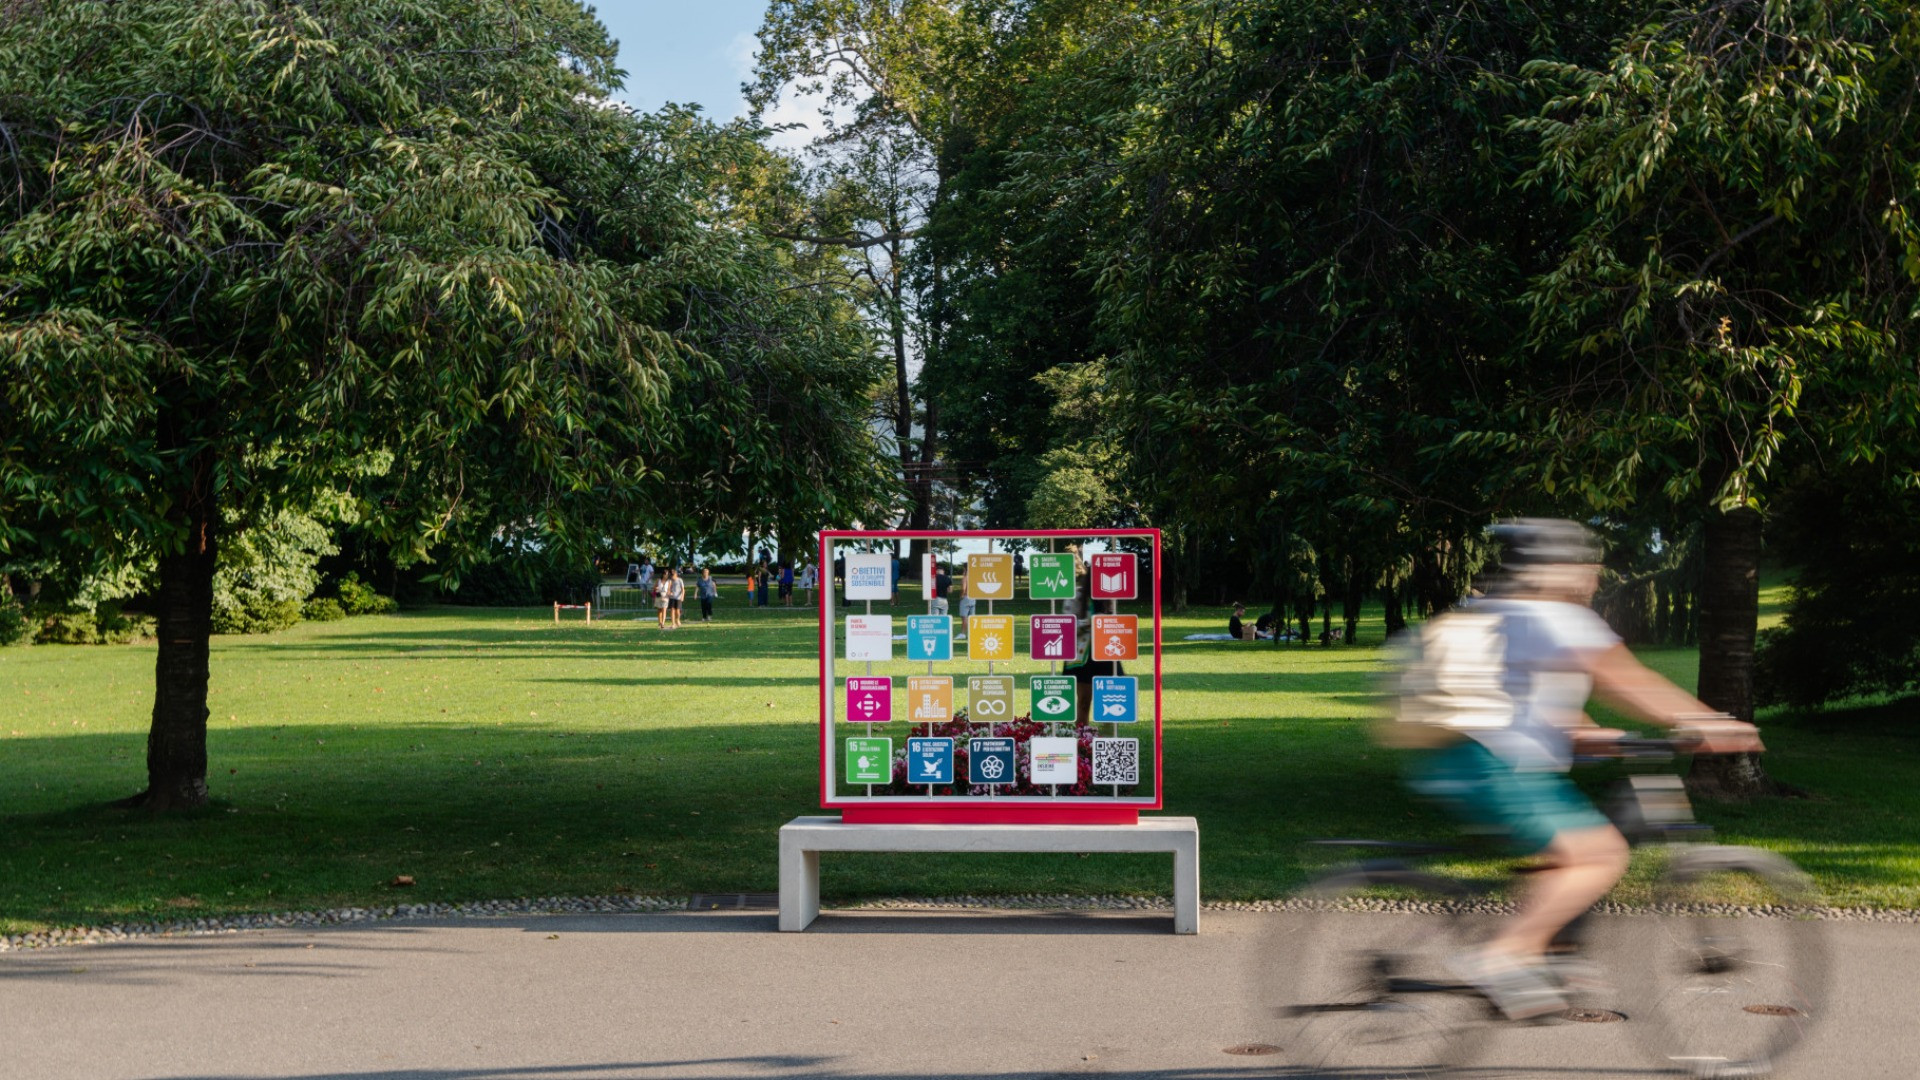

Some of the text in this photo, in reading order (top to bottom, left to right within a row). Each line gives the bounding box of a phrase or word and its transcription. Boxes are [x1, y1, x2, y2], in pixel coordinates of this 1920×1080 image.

[971, 558, 977, 567] 2
[1033, 558, 1039, 568] 3
[1094, 557, 1101, 567] 4
[910, 619, 917, 629] 6
[973, 619, 978, 629] 7
[1034, 618, 1040, 629] 8
[1096, 618, 1103, 629] 9
[849, 680, 859, 691] 10
[910, 680, 918, 690] 11
[972, 680, 980, 690] 12
[1033, 680, 1042, 690] 13
[1095, 680, 1104, 690] 14
[849, 741, 858, 752] 15
[911, 741, 921, 752] 16
[973, 741, 981, 752] 17
